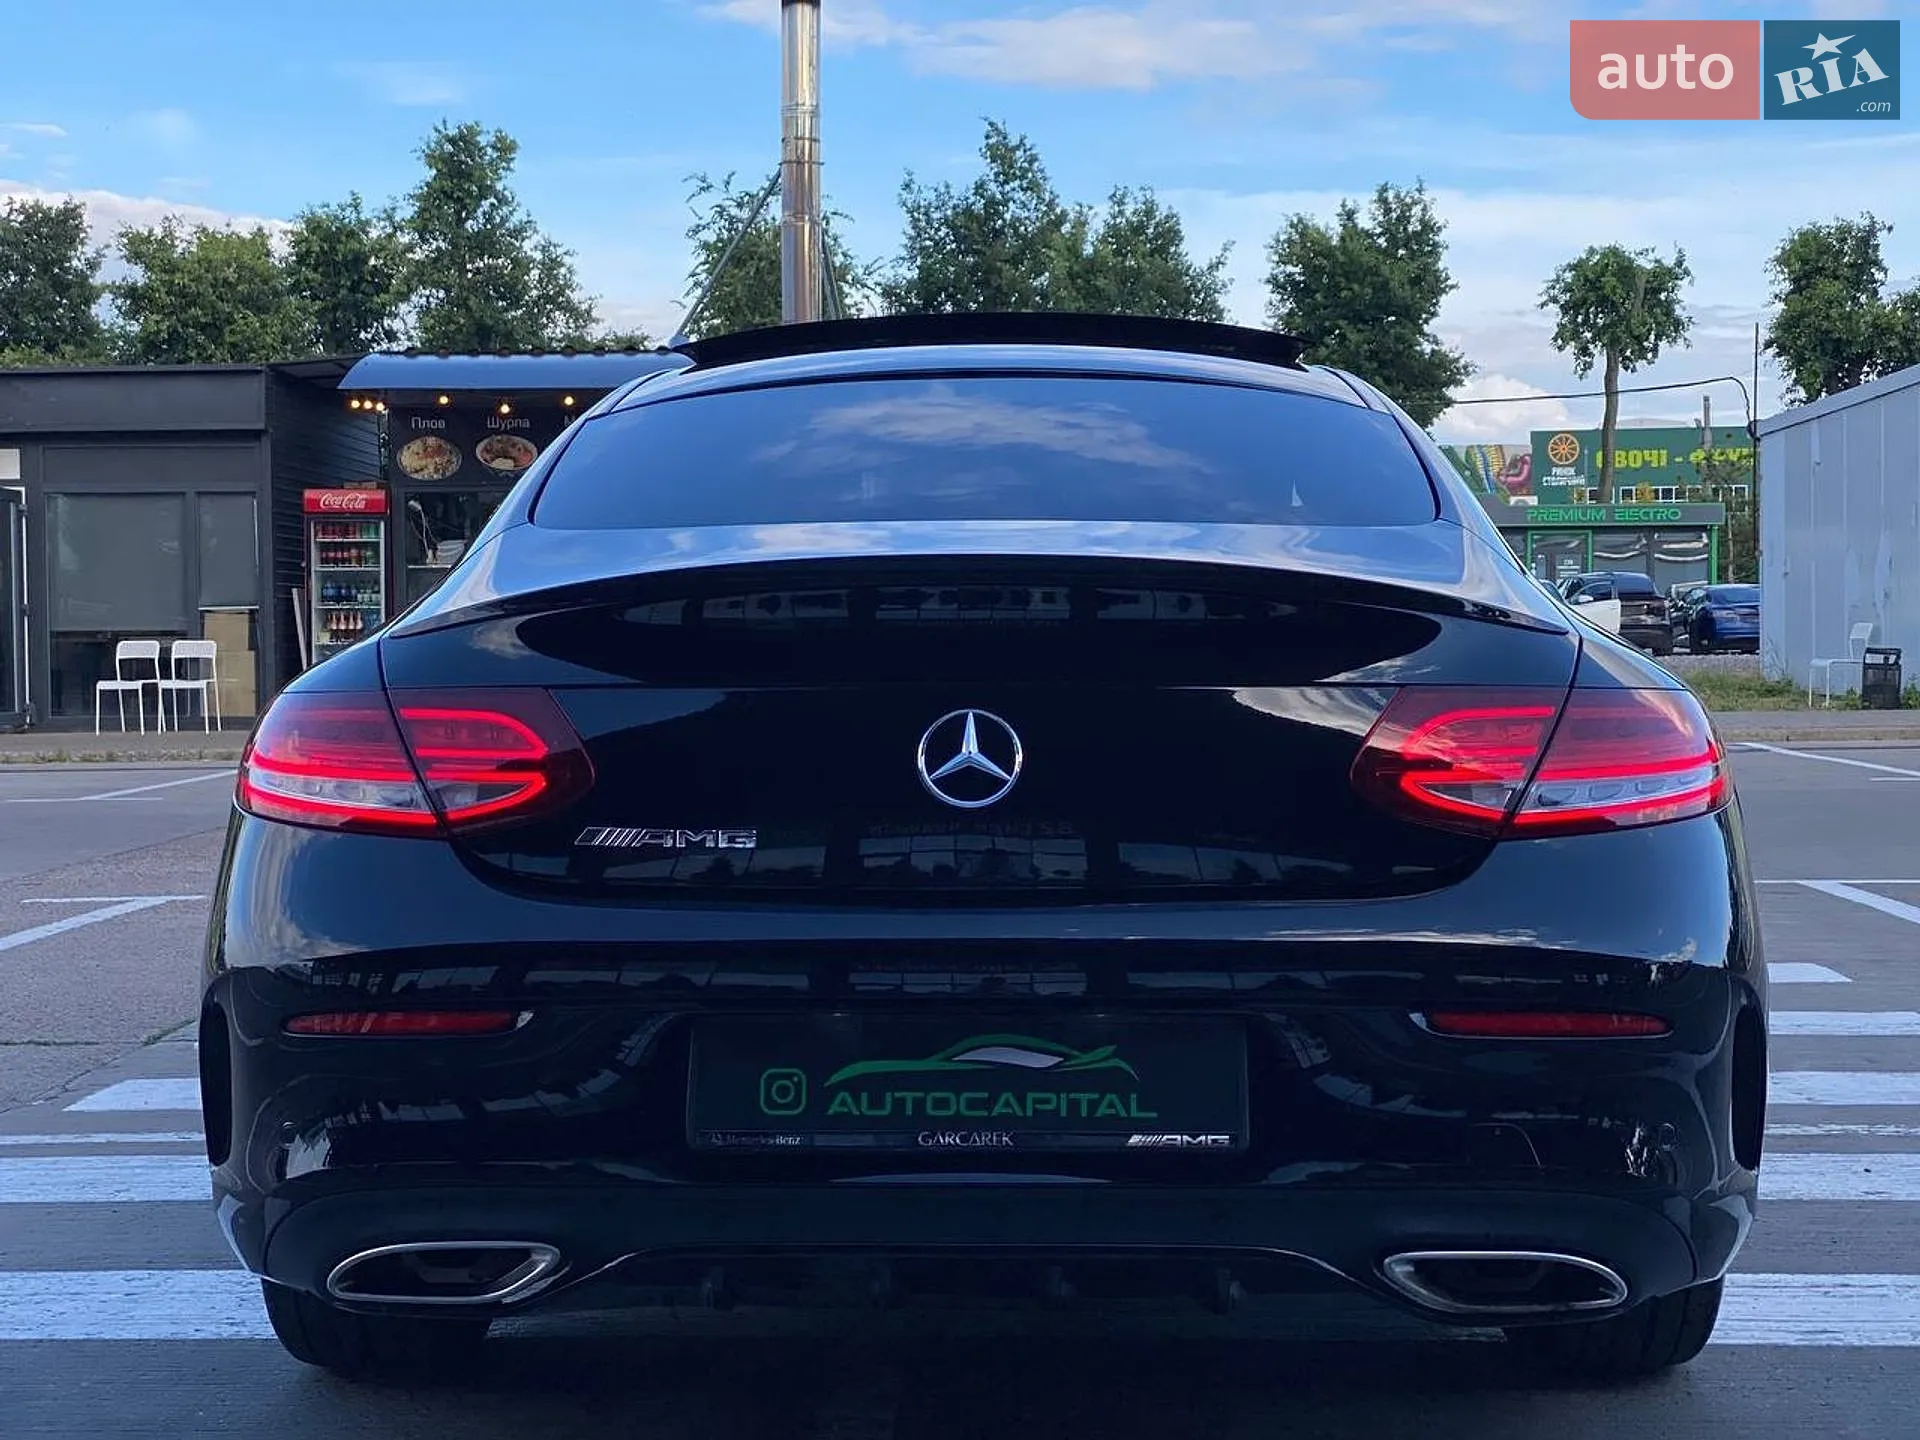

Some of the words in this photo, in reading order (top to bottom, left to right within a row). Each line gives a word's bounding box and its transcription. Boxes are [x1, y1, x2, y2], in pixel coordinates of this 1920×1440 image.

[411, 416, 446, 430] Плов
[486, 416, 531, 431] Шурпа
[1526, 508, 1607, 523] PREMIUM
[1614, 507, 1682, 522] ELECTRO
[631, 828, 757, 848] AMG
[827, 1091, 1159, 1118] AUTOCAPITAL
[1158, 1134, 1230, 1147] AMG
